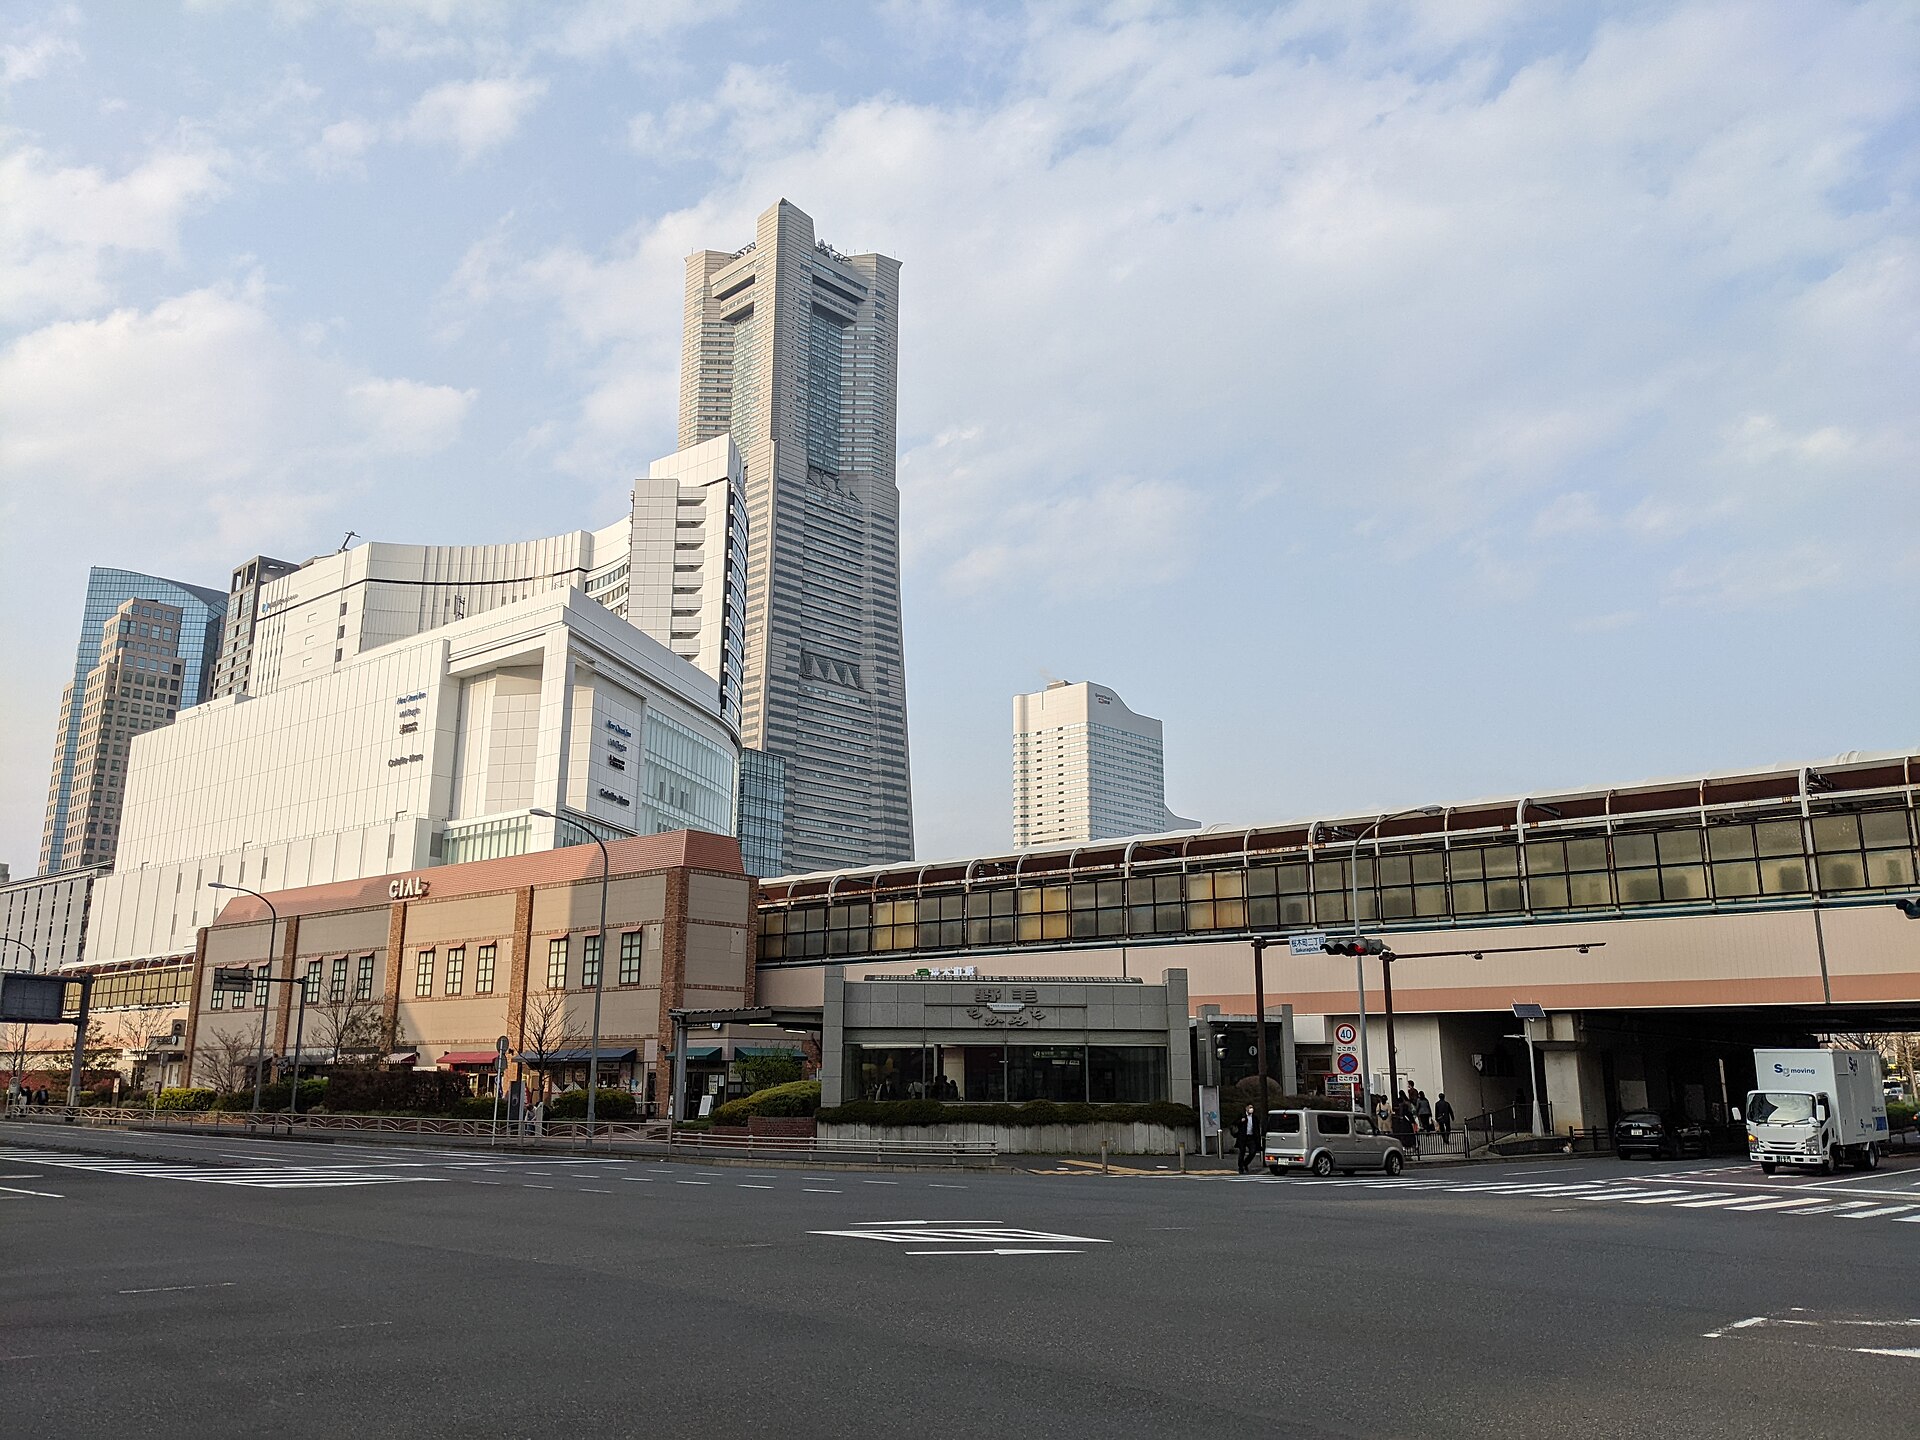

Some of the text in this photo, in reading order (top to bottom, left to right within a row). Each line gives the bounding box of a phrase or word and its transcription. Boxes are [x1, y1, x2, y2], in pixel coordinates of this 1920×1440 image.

[389, 876, 423, 898] CIAL
[1291, 936, 1325, 948] 桜木町二丁目
[1341, 1029, 1352, 1039] 40
[1790, 1067, 1815, 1075] moving
